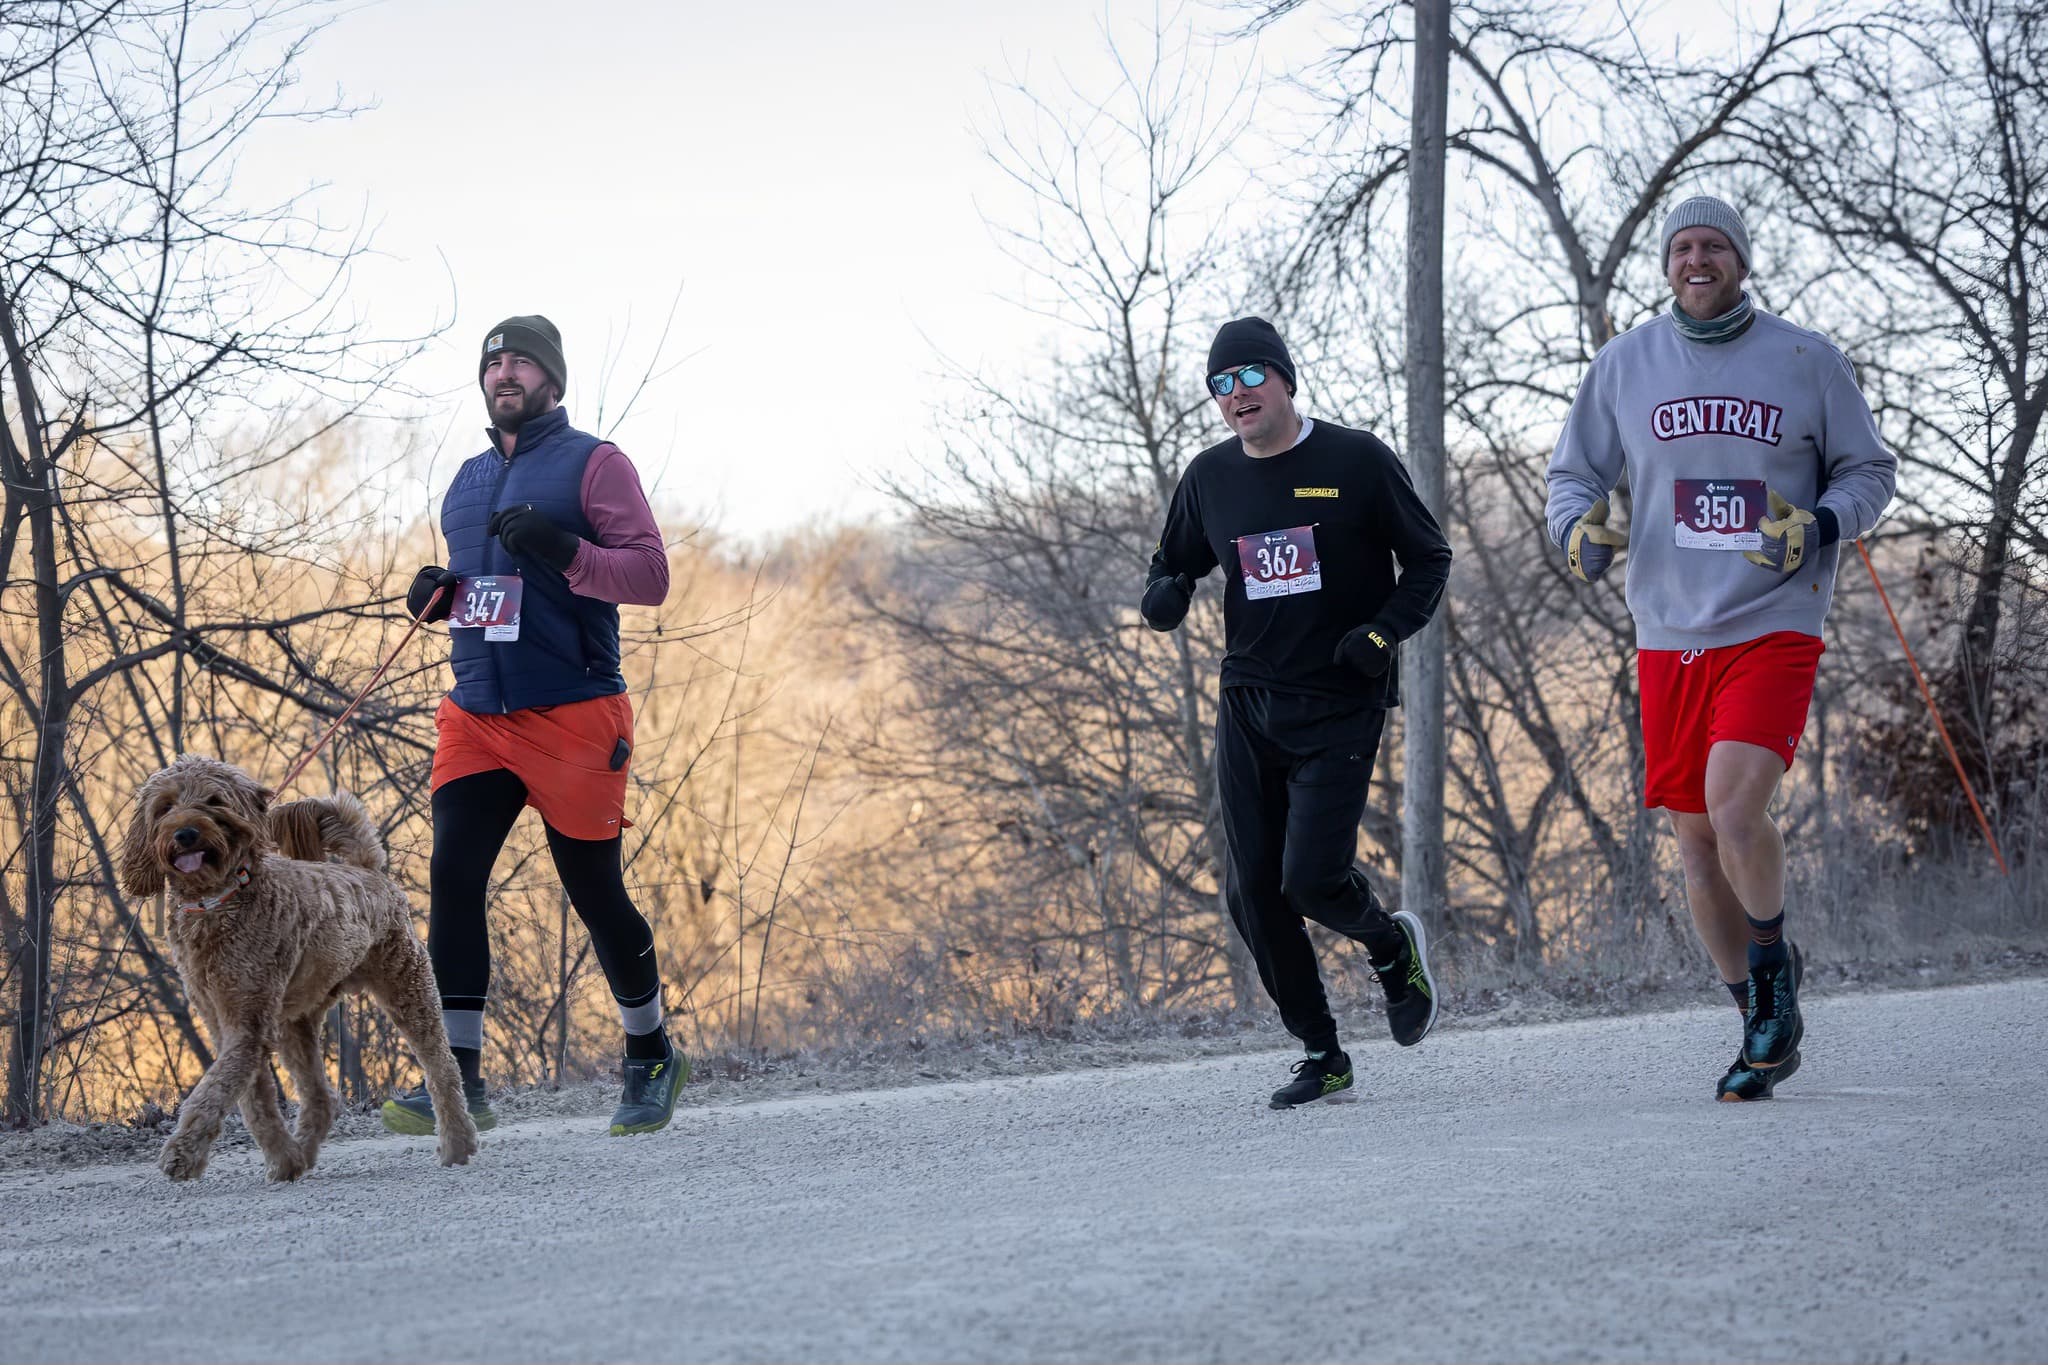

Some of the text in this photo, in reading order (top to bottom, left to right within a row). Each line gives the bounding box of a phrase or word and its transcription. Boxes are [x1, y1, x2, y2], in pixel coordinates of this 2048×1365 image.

[1652, 396, 1782, 446] CENTRAL
[1694, 495, 1746, 529] 350
[1257, 544, 1303, 579] 362
[464, 591, 506, 622] 347
